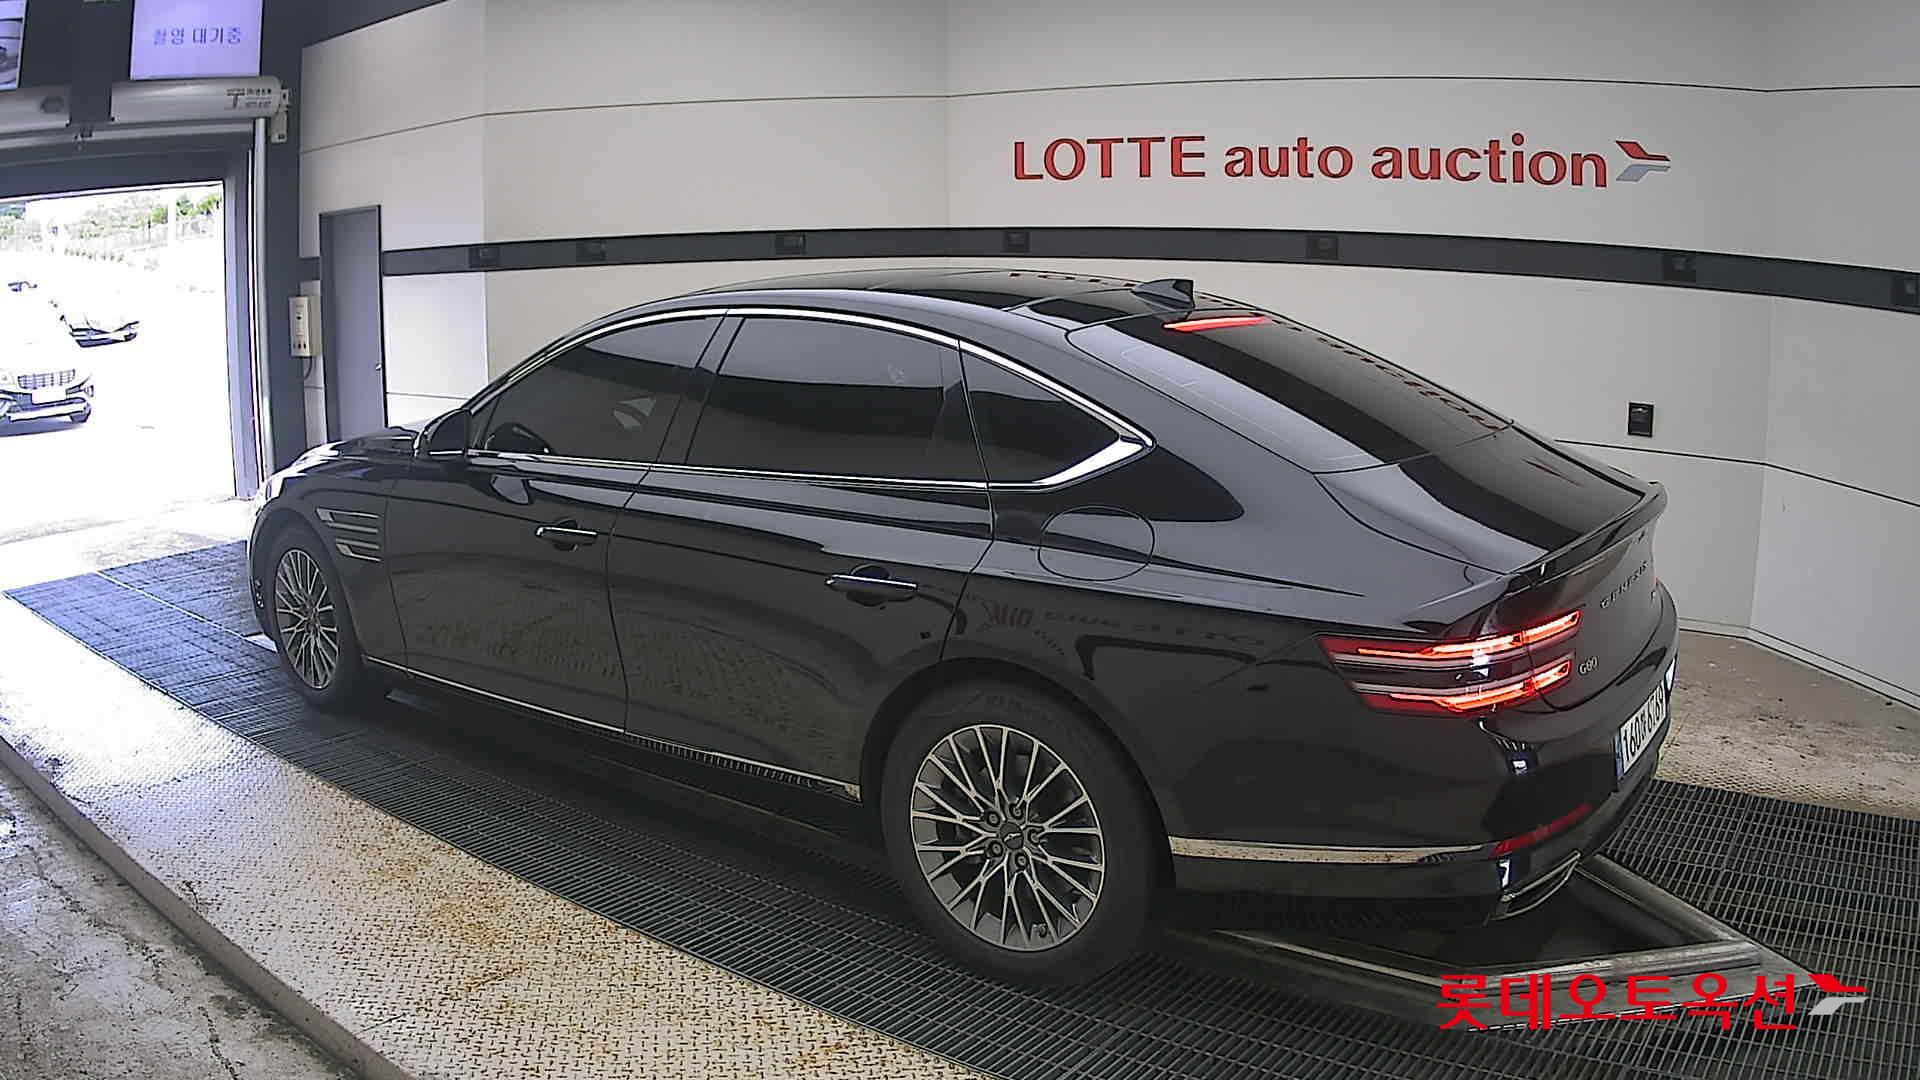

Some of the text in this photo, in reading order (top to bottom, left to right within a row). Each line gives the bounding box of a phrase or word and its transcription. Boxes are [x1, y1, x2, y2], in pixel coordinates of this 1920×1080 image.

[192, 26, 241, 45] 대기중
[1013, 132, 1607, 187] LOTTE auto auction
[1578, 656, 1598, 674] G80
